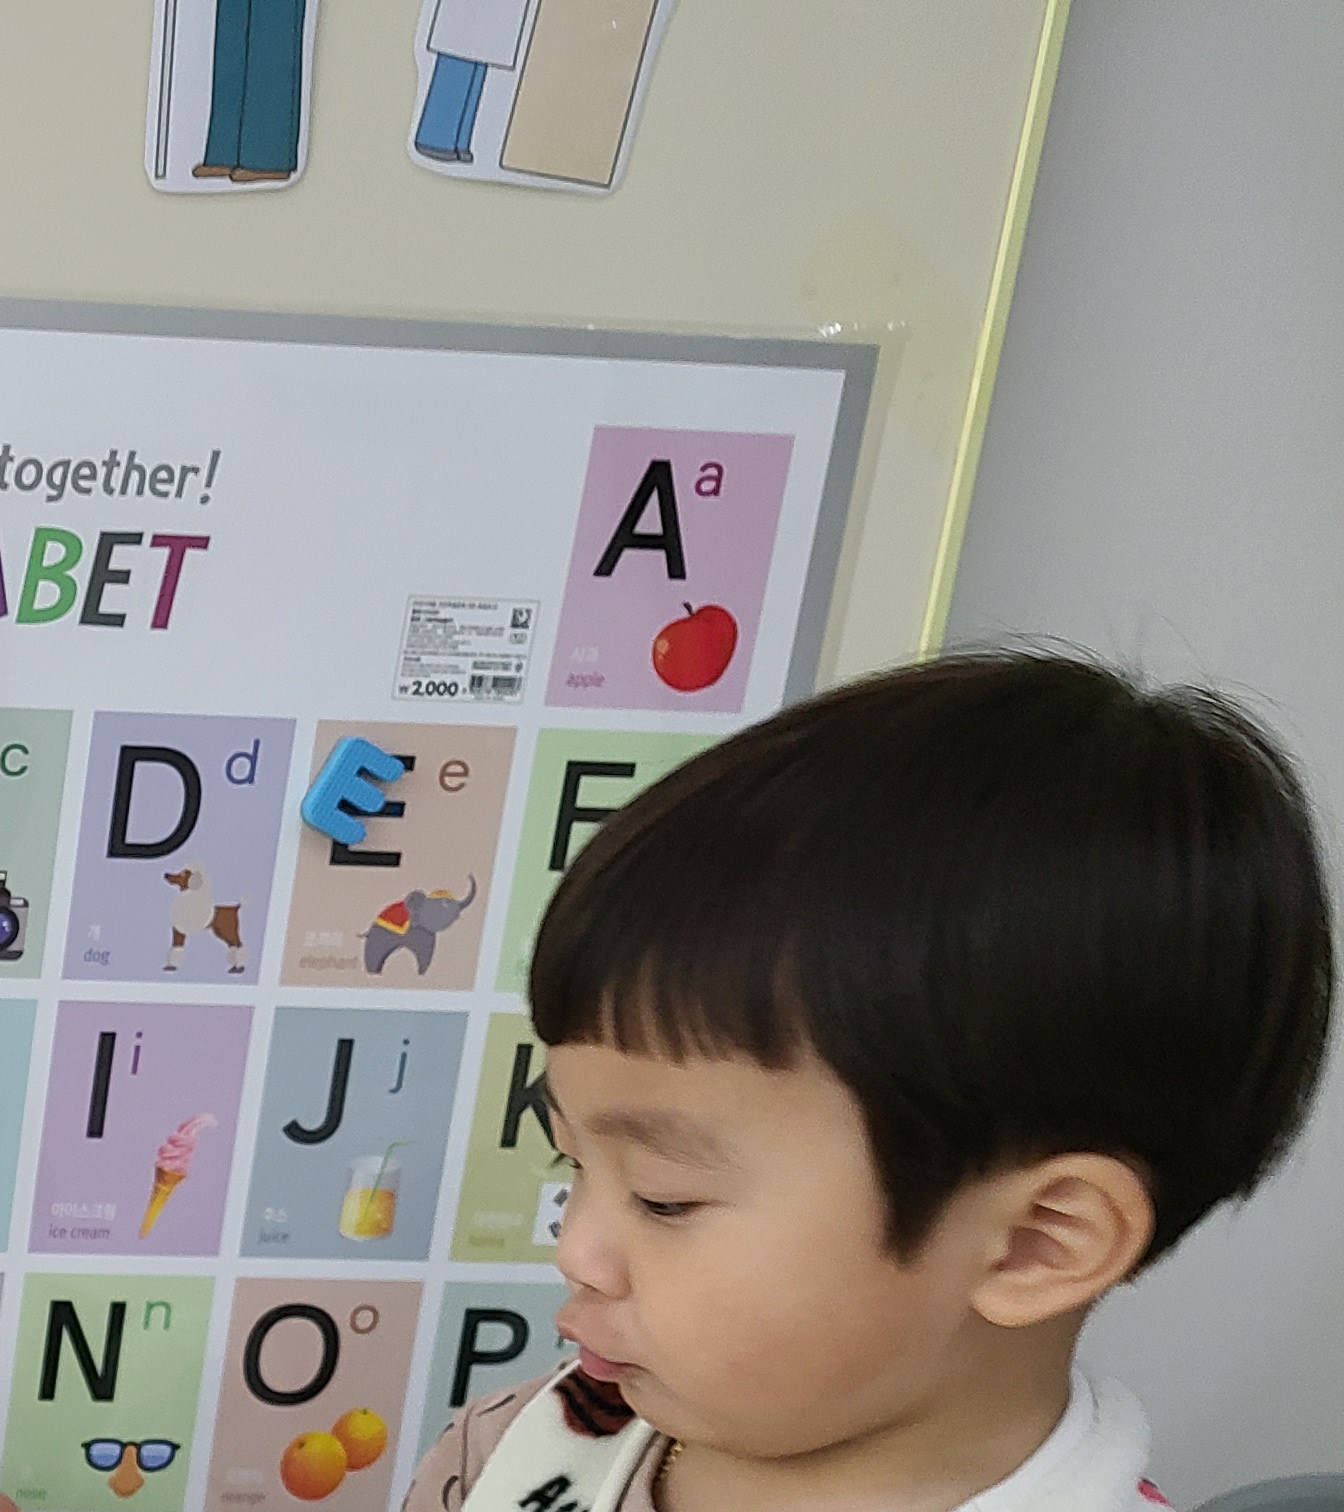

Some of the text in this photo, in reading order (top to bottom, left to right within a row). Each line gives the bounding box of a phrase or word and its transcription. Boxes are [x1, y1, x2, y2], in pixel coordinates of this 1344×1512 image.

[593, 459, 726, 580] A a
[0, 744, 30, 777] c
[107, 738, 261, 858] D d
[302, 736, 407, 845] E
[439, 758, 470, 793] e
[548, 760, 636, 871] F
[84, 948, 111, 965] dog
[86, 1031, 143, 1139] I i
[282, 1038, 411, 1146] J j
[499, 1043, 558, 1148] K
[49, 1224, 111, 1240] ice cream
[37, 1300, 173, 1401] N n
[243, 1303, 381, 1407] O o
[449, 1308, 529, 1407] P
